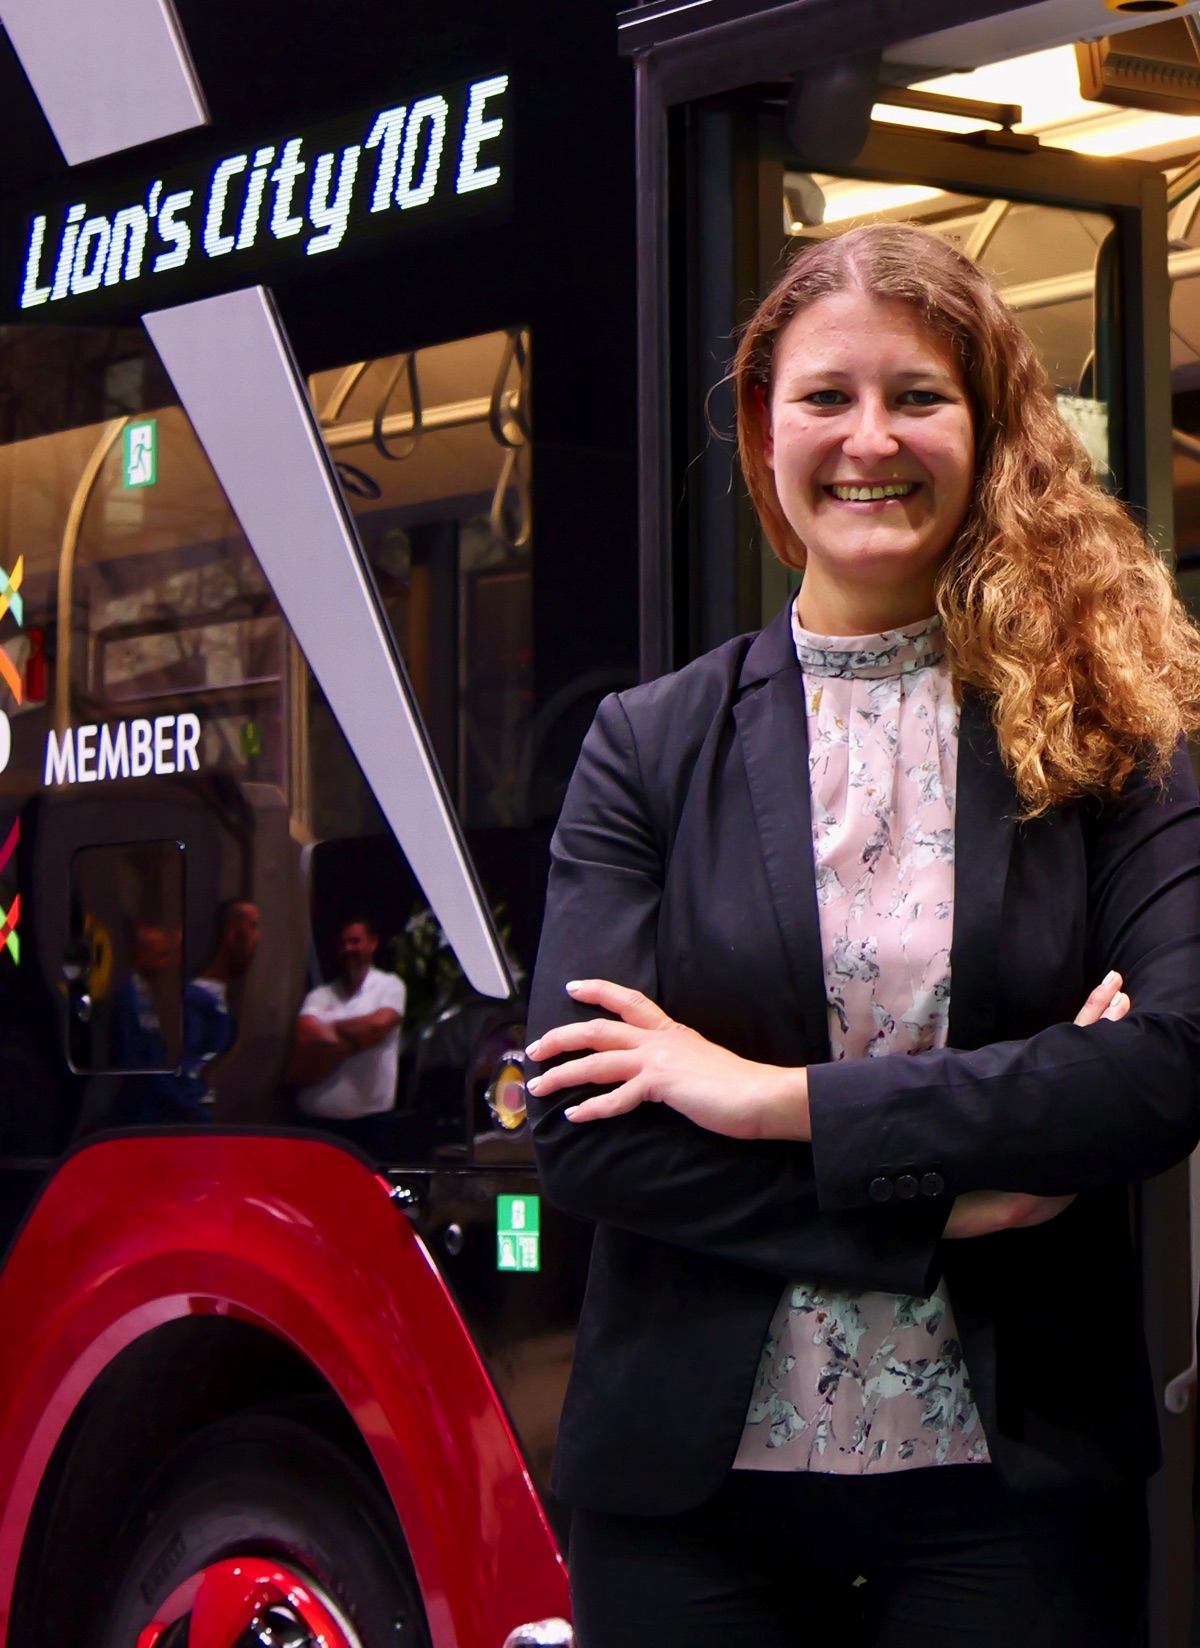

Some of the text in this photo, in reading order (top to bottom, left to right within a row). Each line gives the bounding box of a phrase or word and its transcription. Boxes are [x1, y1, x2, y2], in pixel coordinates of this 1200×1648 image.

[20, 75, 509, 308] Lion's City 10 E
[44, 713, 201, 786] MEMBER
